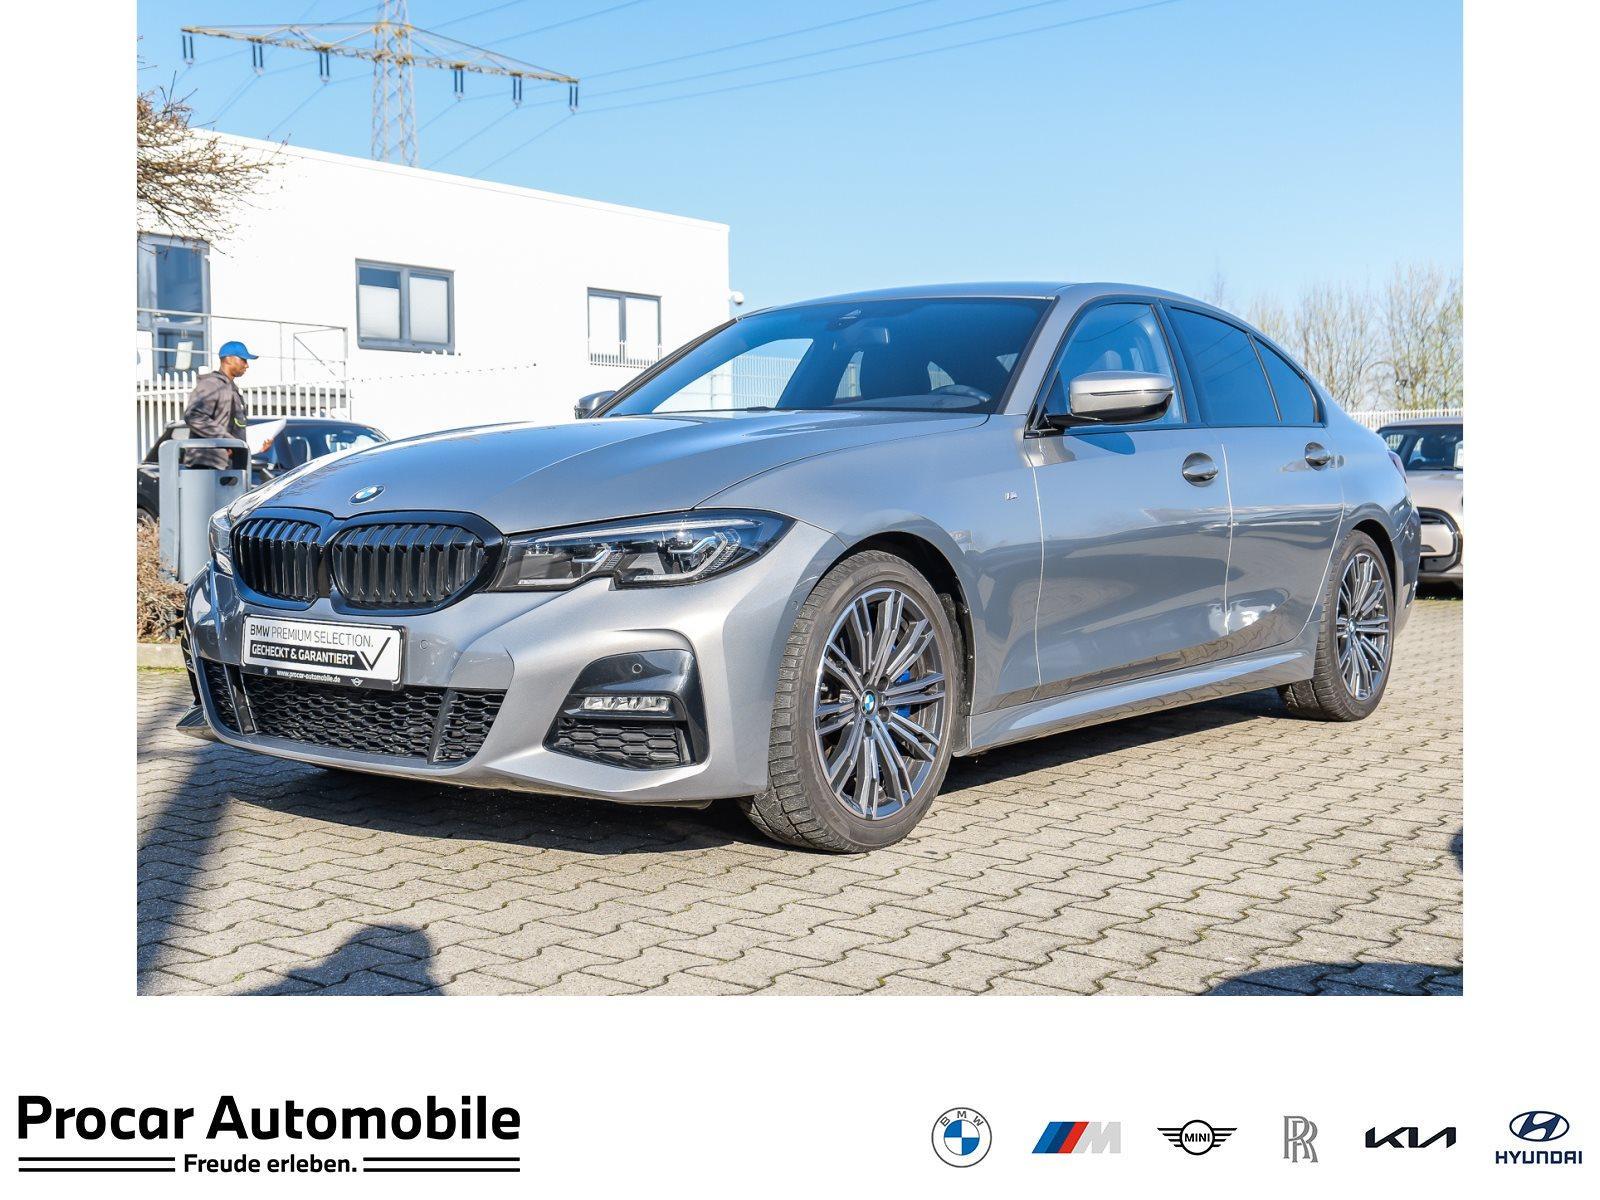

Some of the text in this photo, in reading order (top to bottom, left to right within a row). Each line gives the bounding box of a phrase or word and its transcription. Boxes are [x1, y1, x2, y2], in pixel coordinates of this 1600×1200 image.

[250, 624, 373, 648] BMW PREMIUM SELECTION.
[251, 643, 355, 666] GECHECKT & GARANTIERT
[276, 670, 341, 684] www.procar-automobile.de
